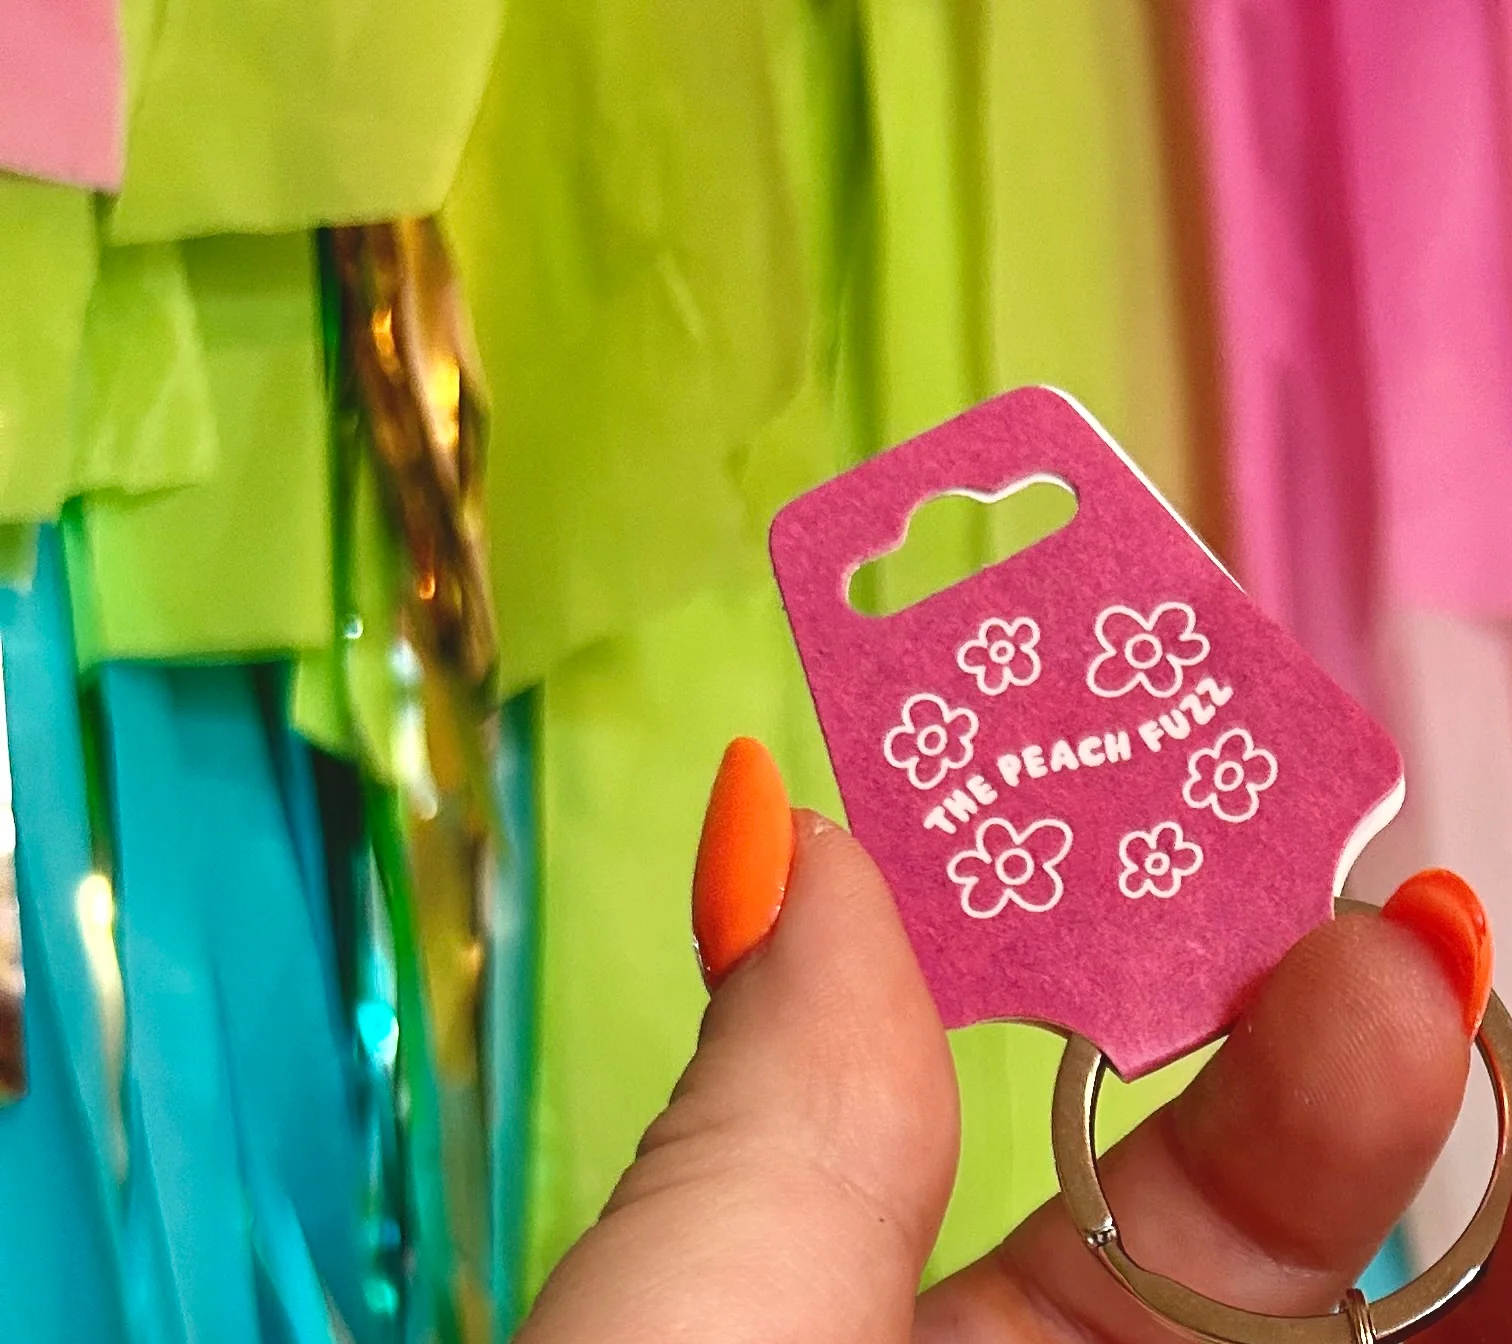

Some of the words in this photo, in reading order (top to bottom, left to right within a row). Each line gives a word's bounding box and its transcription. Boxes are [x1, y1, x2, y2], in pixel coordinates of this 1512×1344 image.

[922, 774, 998, 835] THE
[996, 730, 1133, 788] PEACH
[1137, 677, 1234, 753] FUZZ
